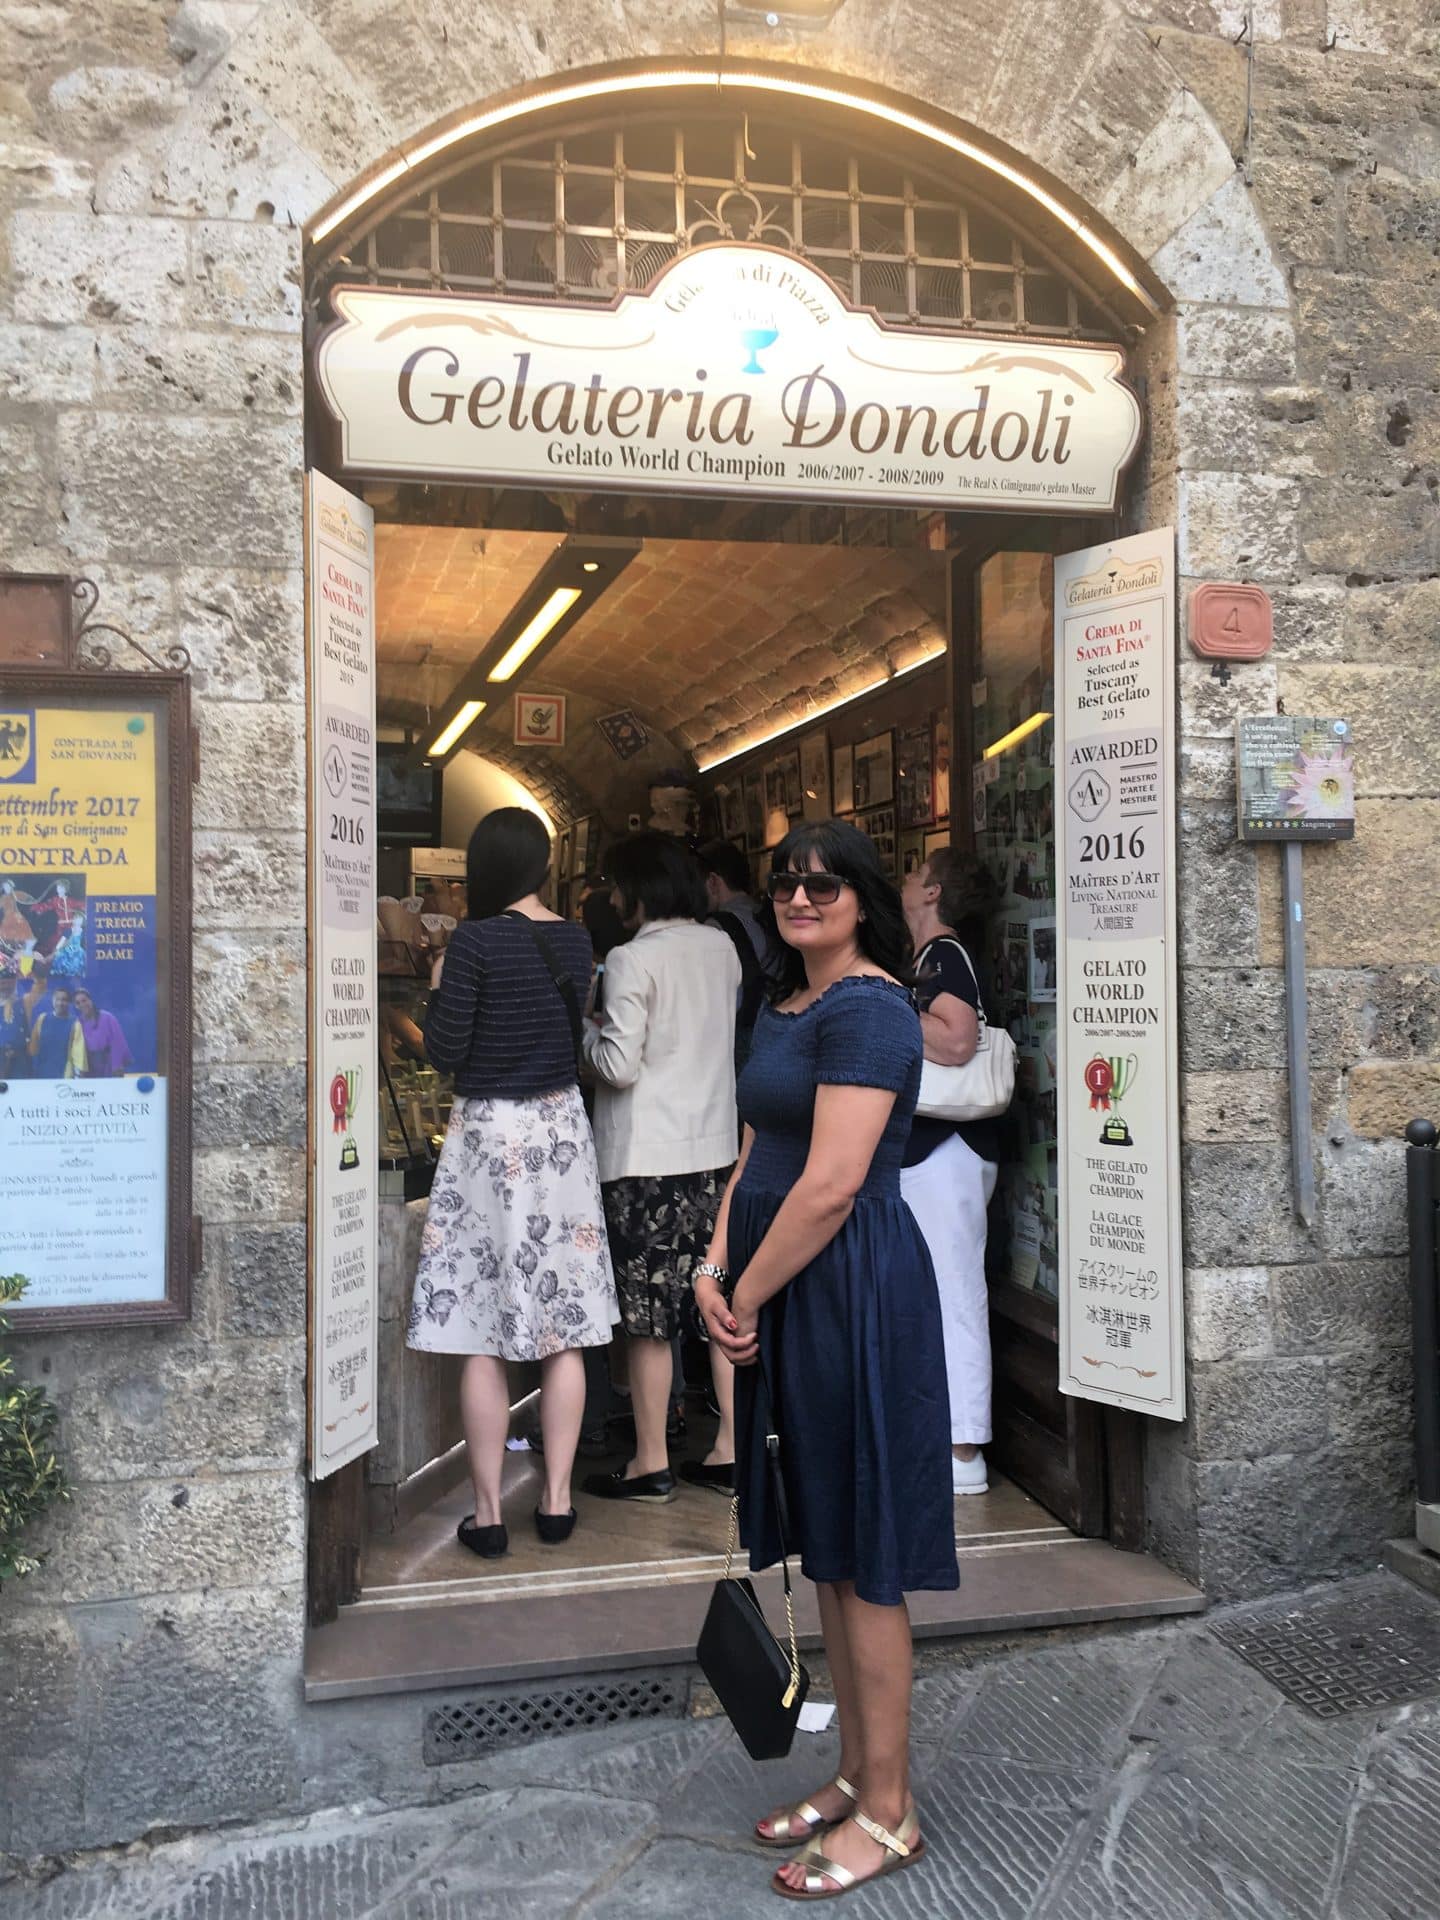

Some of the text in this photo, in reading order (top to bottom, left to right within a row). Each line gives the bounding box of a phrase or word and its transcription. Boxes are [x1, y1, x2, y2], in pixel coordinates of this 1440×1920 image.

[752, 264, 771, 284] di
[778, 271, 830, 325] Piazza
[398, 346, 1074, 466] Gelateria Dondoli
[547, 441, 613, 468] Gelato
[620, 445, 680, 471] World
[686, 450, 786, 481] Champion
[797, 463, 865, 481] 2006/2007
[878, 468, 944, 486] 2008/2009
[958, 476, 972, 489] The
[974, 477, 990, 490] Real
[992, 480, 998, 490] S.
[1001, 478, 1046, 494] Gimignano's
[1048, 481, 1069, 495] gelato
[1071, 483, 1096, 496] Master
[1068, 571, 1158, 604] Gelateria Dondoli
[1084, 624, 1125, 641] CREMA
[324, 642, 368, 674] Best Gelato
[1076, 643, 1112, 662] SANTA
[1087, 658, 1140, 676] Selected as
[1084, 672, 1138, 693] Tuscany
[1078, 686, 1150, 710] Best Gelato
[1102, 708, 1126, 721] 2015
[324, 716, 370, 745] AWARDED
[50, 750, 74, 760] SAN
[1070, 737, 1158, 766] AWARDED
[1120, 773, 1158, 784] MAESTRO
[1120, 784, 1154, 795] D'ARTE E
[0, 787, 140, 818] ettembre 2017
[1120, 794, 1158, 805] MESTIERE
[63, 820, 128, 844] Gimignano
[330, 813, 364, 846] 2016
[1080, 826, 1146, 863] 2016
[0, 847, 128, 866] ONTRADA
[95, 902, 144, 913] PREMIO
[95, 917, 146, 930] TRECCIA
[95, 933, 134, 945] DELLE
[95, 949, 134, 961] DAME
[331, 957, 366, 977] GELATO
[1083, 960, 1146, 977] GELATO
[332, 983, 364, 1001] WORLD
[1086, 983, 1144, 1001] WORLD
[325, 1008, 371, 1028] CHAMPION
[1072, 1006, 1160, 1025] CHAMPION
[4, 1106, 15, 1118] A
[20, 1105, 49, 1119] tutti
[64, 1105, 92, 1118] soci
[97, 1103, 150, 1116] AUSER
[22, 1124, 68, 1137] INIZIO
[1086, 1158, 1148, 1175] THE GELATO
[1098, 1172, 1136, 1186] WORLD
[1090, 1184, 1144, 1201] CHAMPION
[1092, 1210, 1142, 1228] LA GLACE
[1089, 1223, 1146, 1240] CHAMPION
[1089, 1234, 1146, 1254] DU MONDE
[1079, 1258, 1158, 1285] アイスクリームの
[1078, 1274, 1160, 1301] 世界チャンピオン
